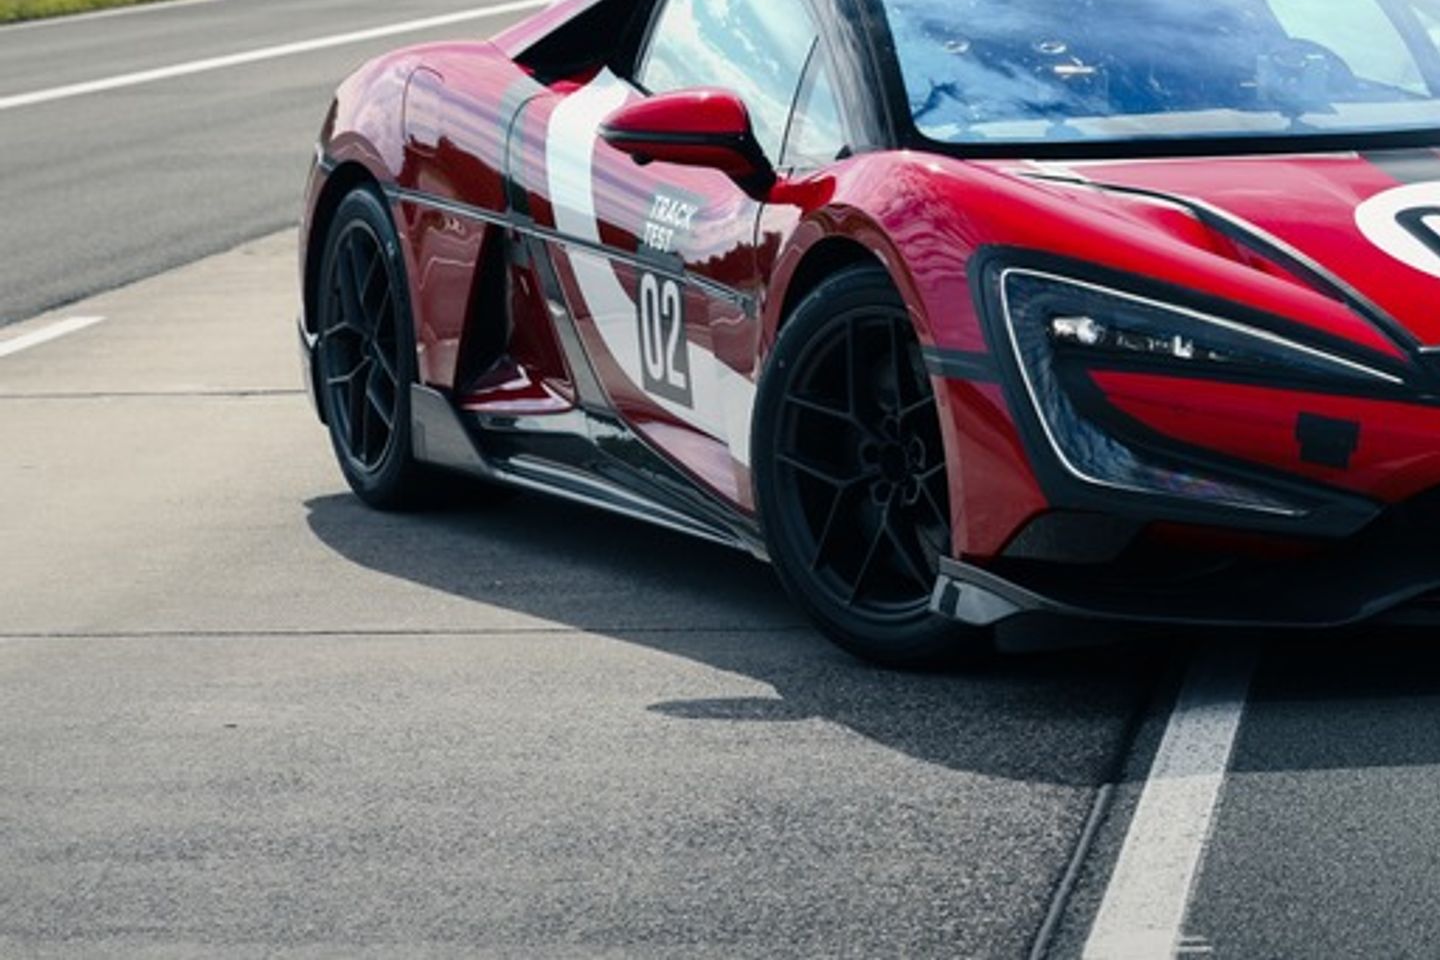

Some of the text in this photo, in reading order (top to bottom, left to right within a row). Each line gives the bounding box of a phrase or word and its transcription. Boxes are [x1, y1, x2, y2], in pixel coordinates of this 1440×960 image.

[650, 194, 699, 231] TRACK
[644, 221, 674, 253] TEST
[640, 272, 687, 388] 02
